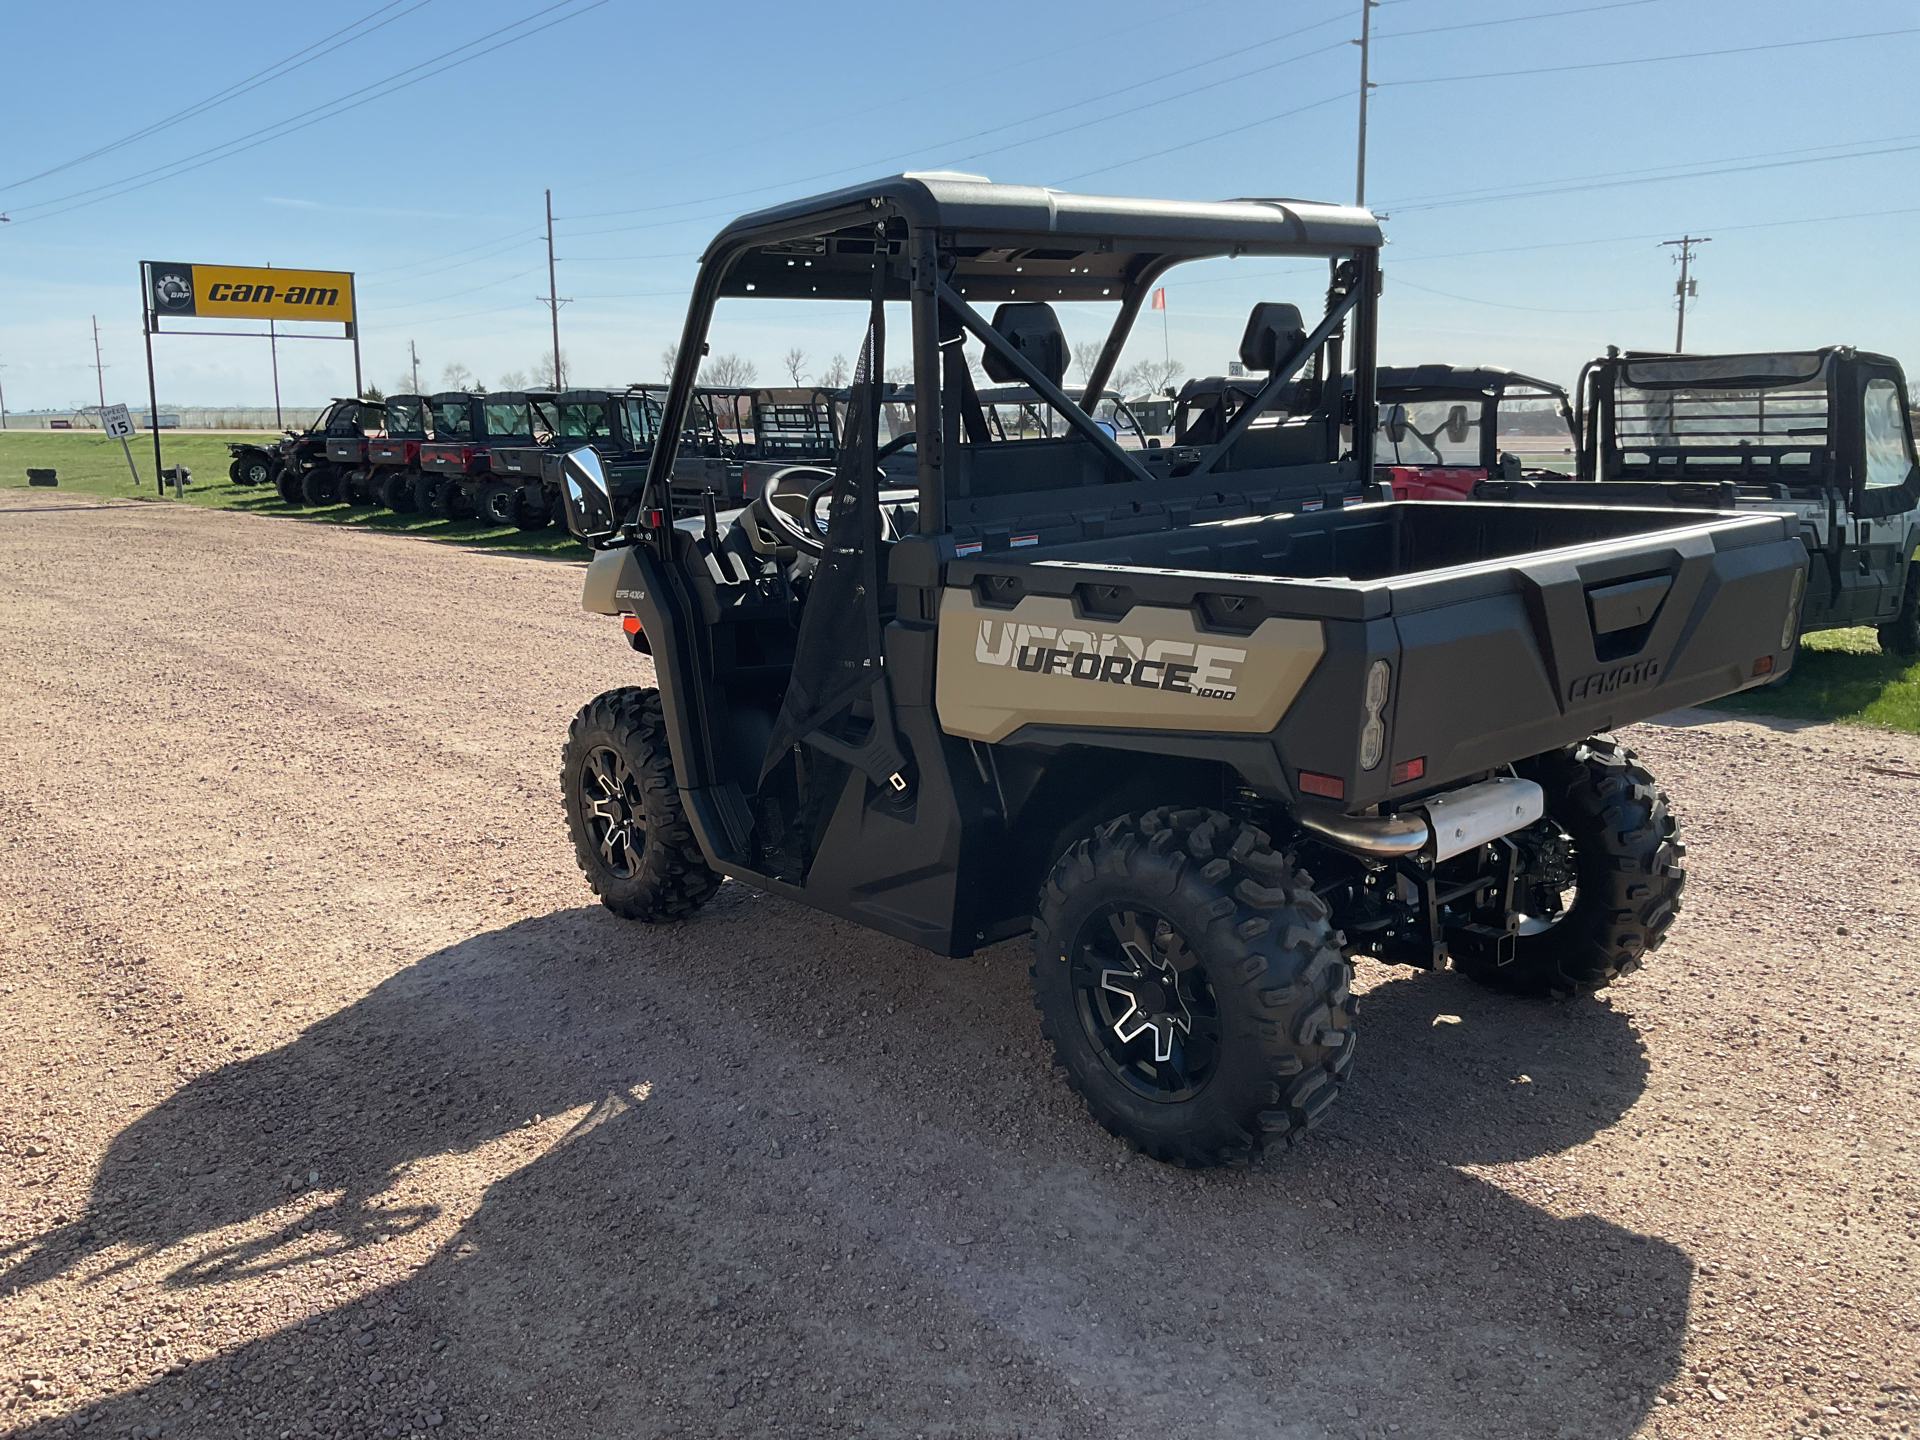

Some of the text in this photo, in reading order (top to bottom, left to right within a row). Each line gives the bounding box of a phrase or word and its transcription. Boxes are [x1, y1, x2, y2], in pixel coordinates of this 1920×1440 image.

[170, 291, 190, 299] BRP
[207, 283, 339, 306] can-am
[102, 407, 126, 417] SPEED
[107, 414, 125, 423] LIMIT
[110, 421, 129, 435] 15
[615, 590, 629, 598] EPS
[1017, 645, 1236, 701] UFORCE 1000
[1568, 658, 1659, 702] CFMOTO
